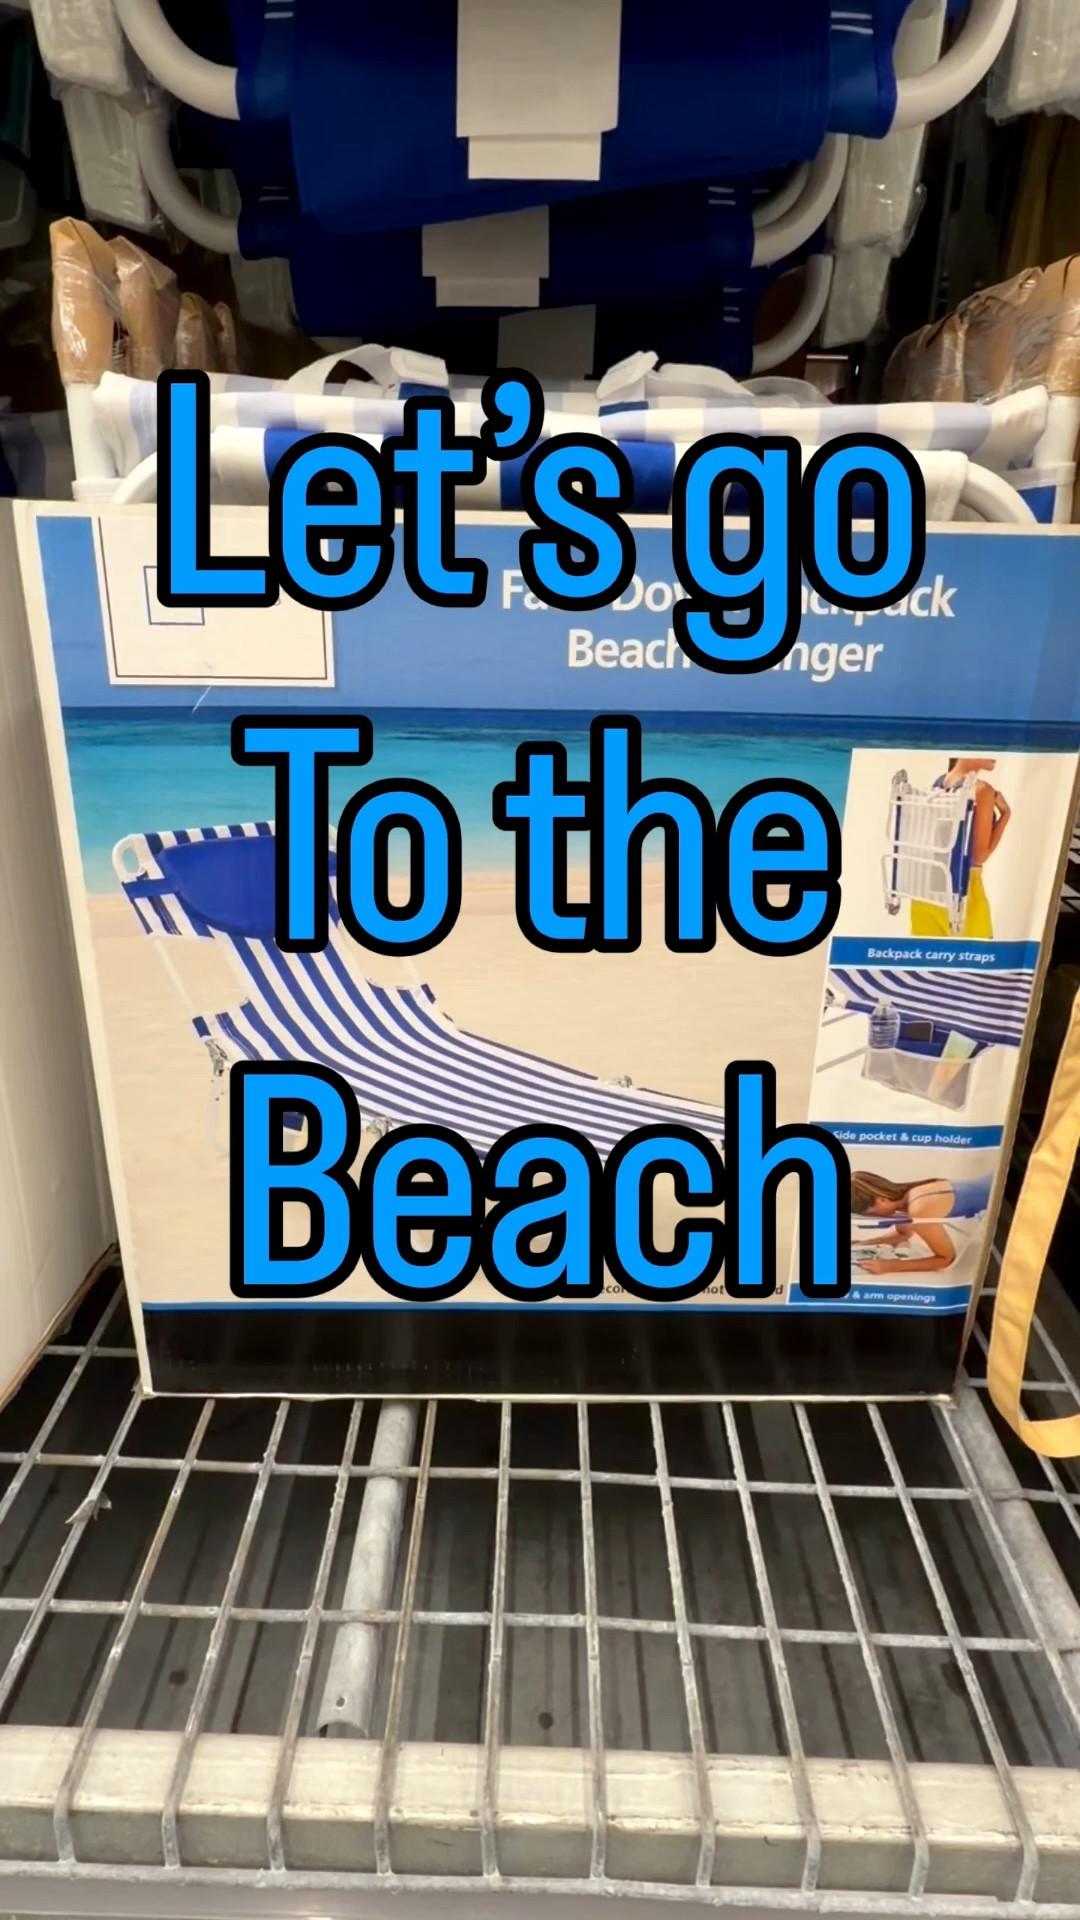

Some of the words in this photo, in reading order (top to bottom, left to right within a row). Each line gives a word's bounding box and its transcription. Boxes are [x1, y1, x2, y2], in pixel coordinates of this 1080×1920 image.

[867, 947, 922, 960] Backpack
[925, 950, 956, 962] carry
[958, 951, 995, 964] straps
[833, 1130, 857, 1140] Side
[859, 1131, 897, 1142] pocket
[900, 1132, 909, 1141] &
[911, 1134, 932, 1144] cup
[934, 1133, 973, 1144] holder
[852, 1291, 861, 1299] &
[863, 1292, 884, 1300] arm
[886, 1292, 936, 1303] openings
